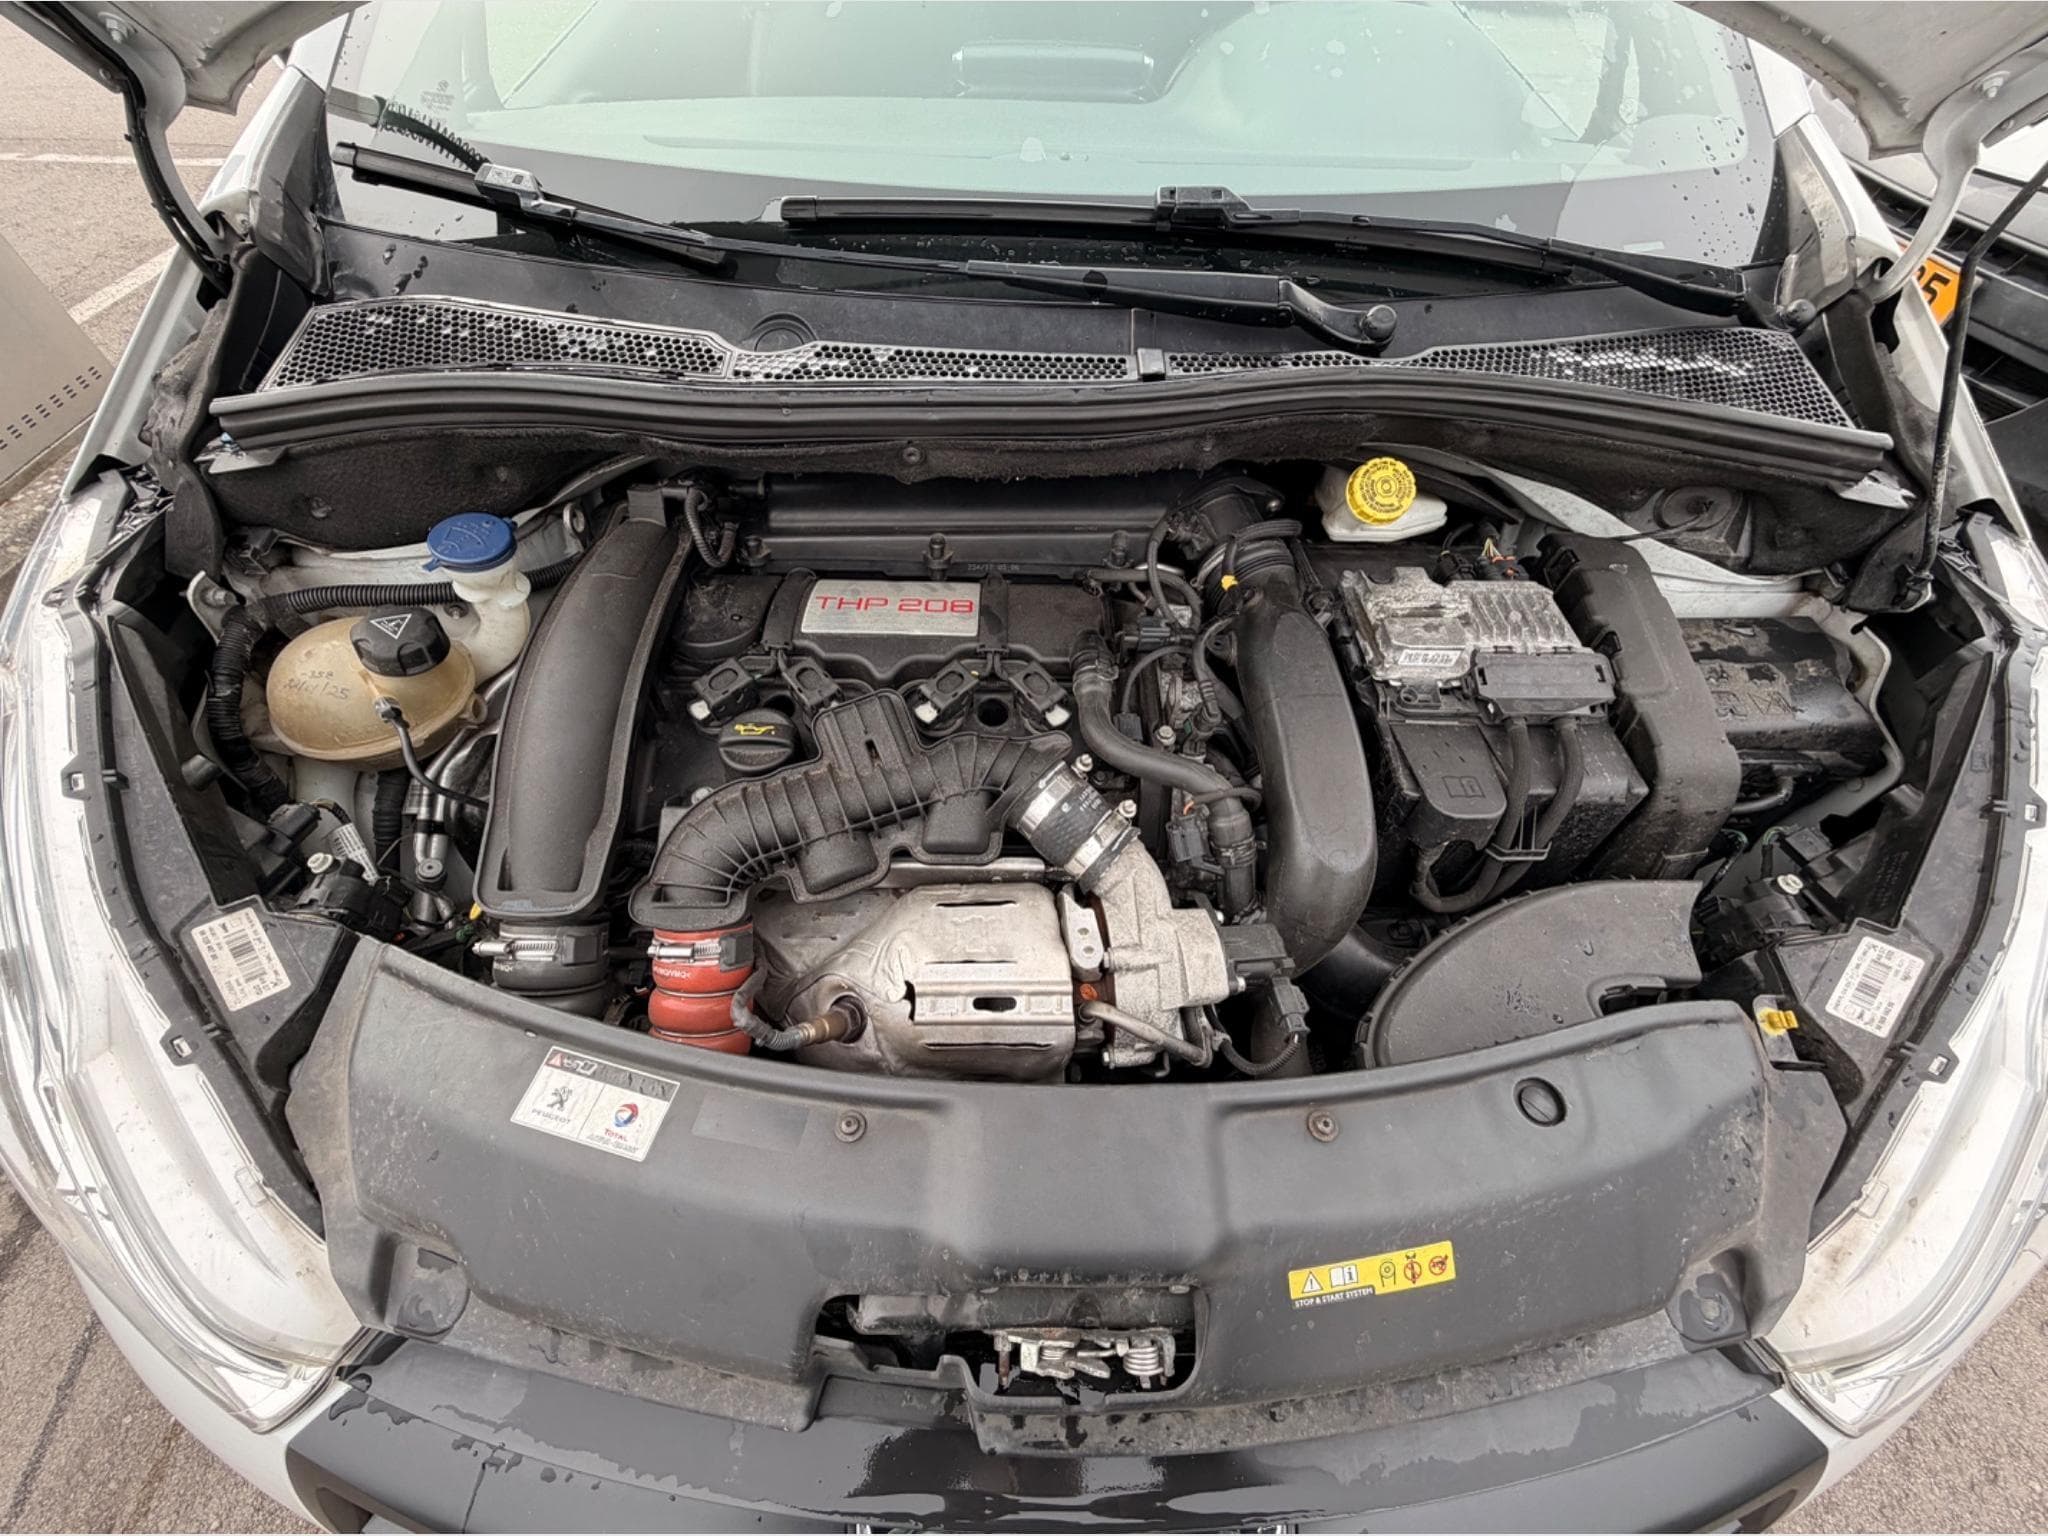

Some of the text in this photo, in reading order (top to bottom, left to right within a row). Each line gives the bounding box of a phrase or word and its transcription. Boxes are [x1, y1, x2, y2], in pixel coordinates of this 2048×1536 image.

[815, 596, 974, 613] THP 208
[531, 1108, 572, 1126] PEUGEOT
[604, 1128, 629, 1143] TOTAL
[1294, 1287, 1374, 1308] STOP & START SYSTEM
